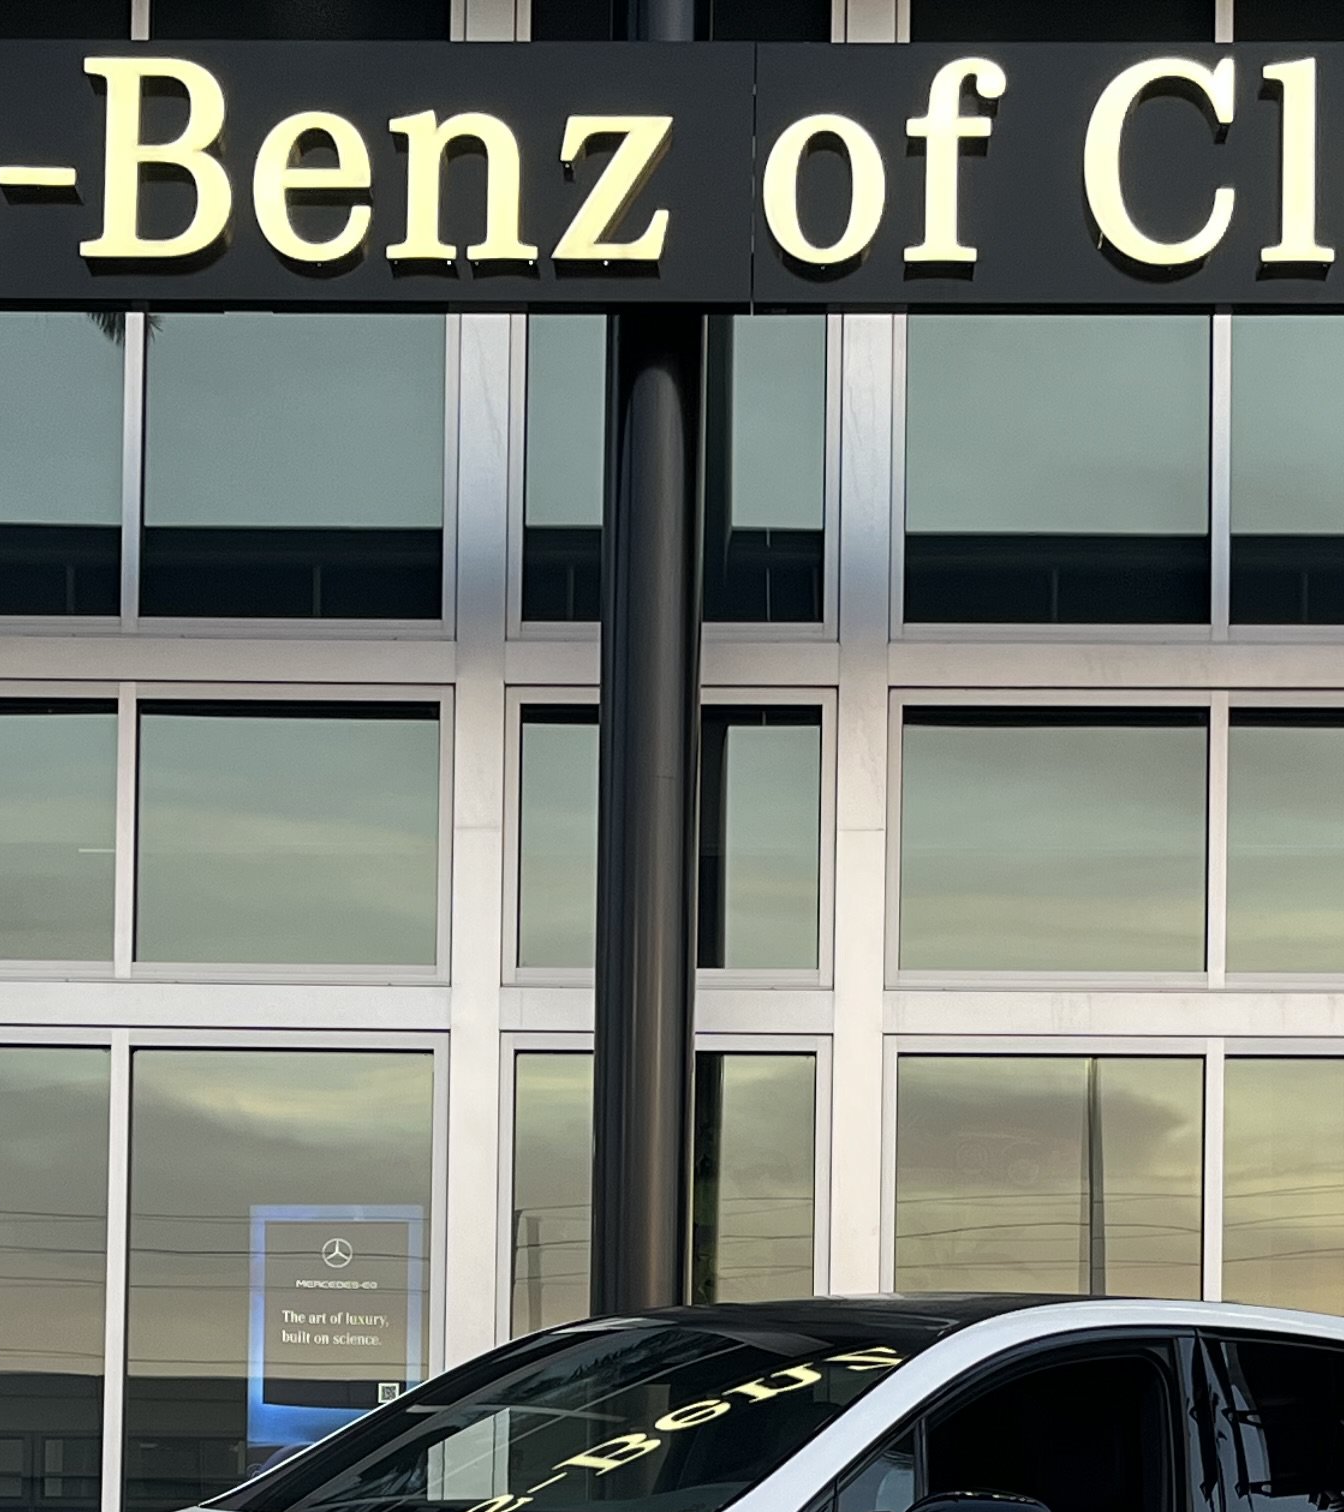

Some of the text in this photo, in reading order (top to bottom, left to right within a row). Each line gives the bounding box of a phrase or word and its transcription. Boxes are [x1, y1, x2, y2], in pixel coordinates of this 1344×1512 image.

[763, 57, 1008, 266] of
[295, 1279, 378, 1290] MERCEDES-EQ
[281, 1309, 390, 1329] The art of luxury,
[281, 1329, 383, 1346] built on science.
